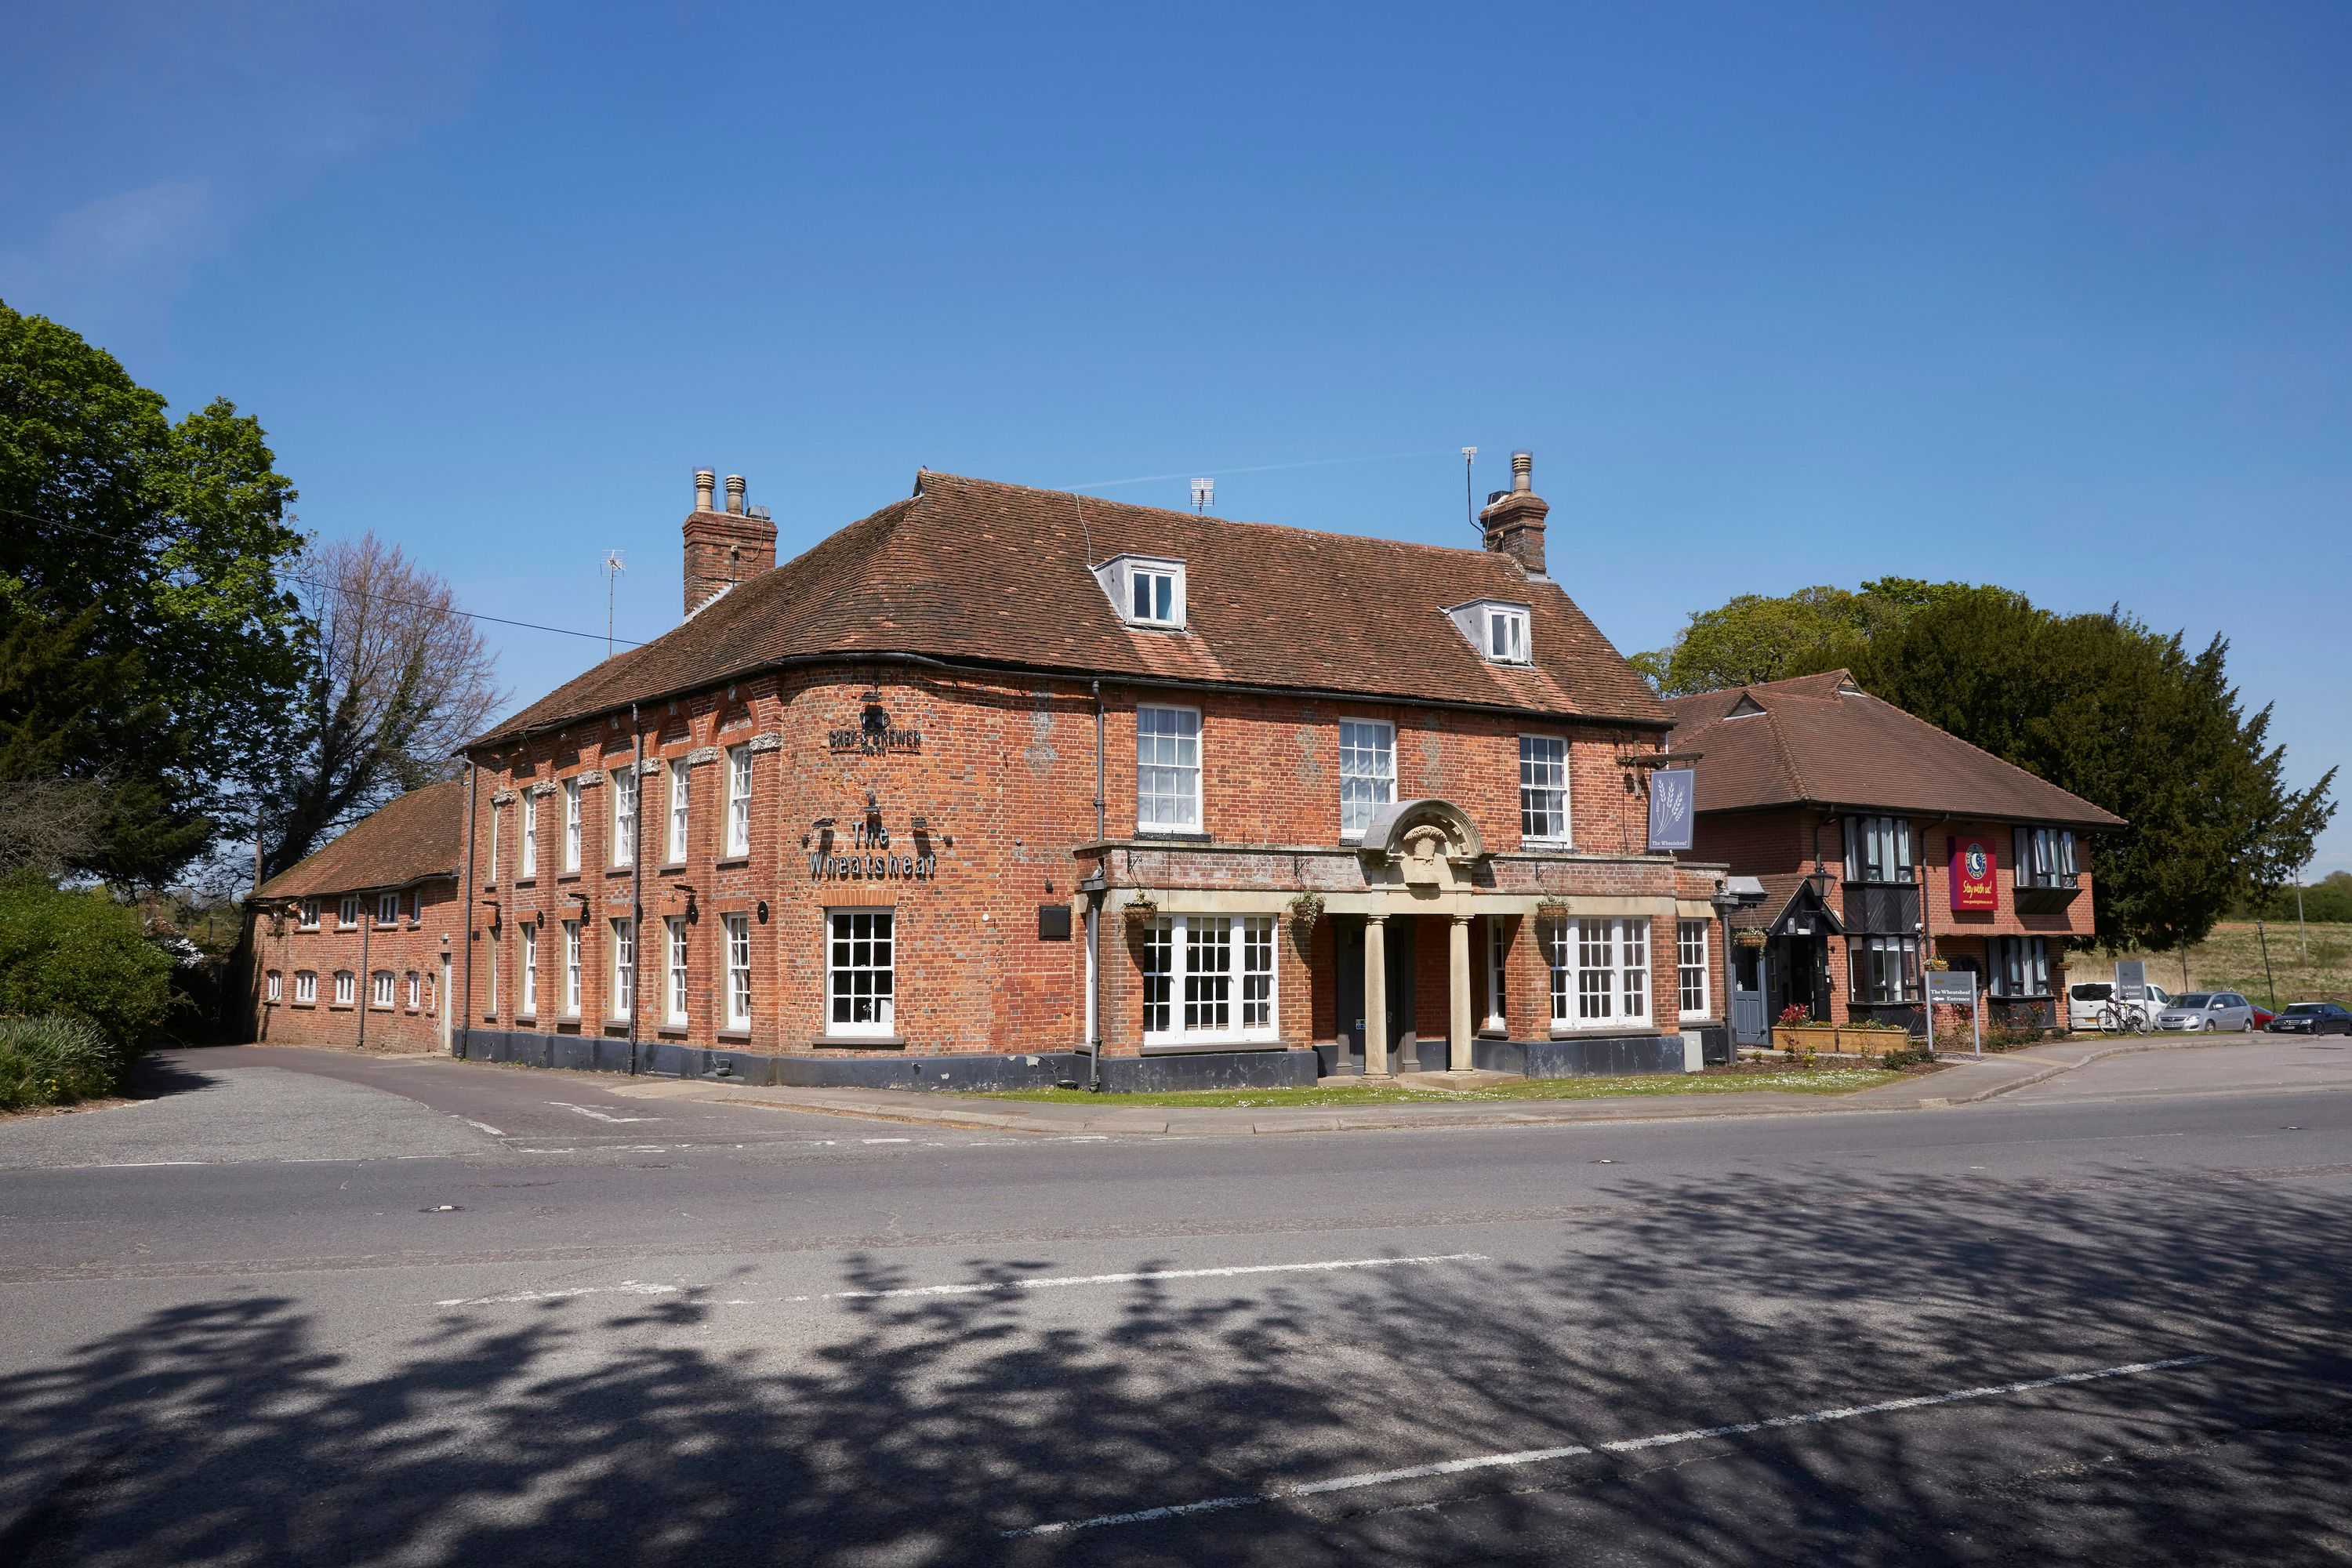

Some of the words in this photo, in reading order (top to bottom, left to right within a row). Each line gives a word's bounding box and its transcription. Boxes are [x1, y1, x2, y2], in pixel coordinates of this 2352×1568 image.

[829, 729, 857, 746] CHEF
[860, 730, 868, 746] &
[873, 729, 920, 747] BREWER
[852, 821, 890, 845] The
[809, 851, 935, 876] Wheatsheaf
[1963, 880, 1973, 898] Stay
[1973, 883, 1984, 894] with
